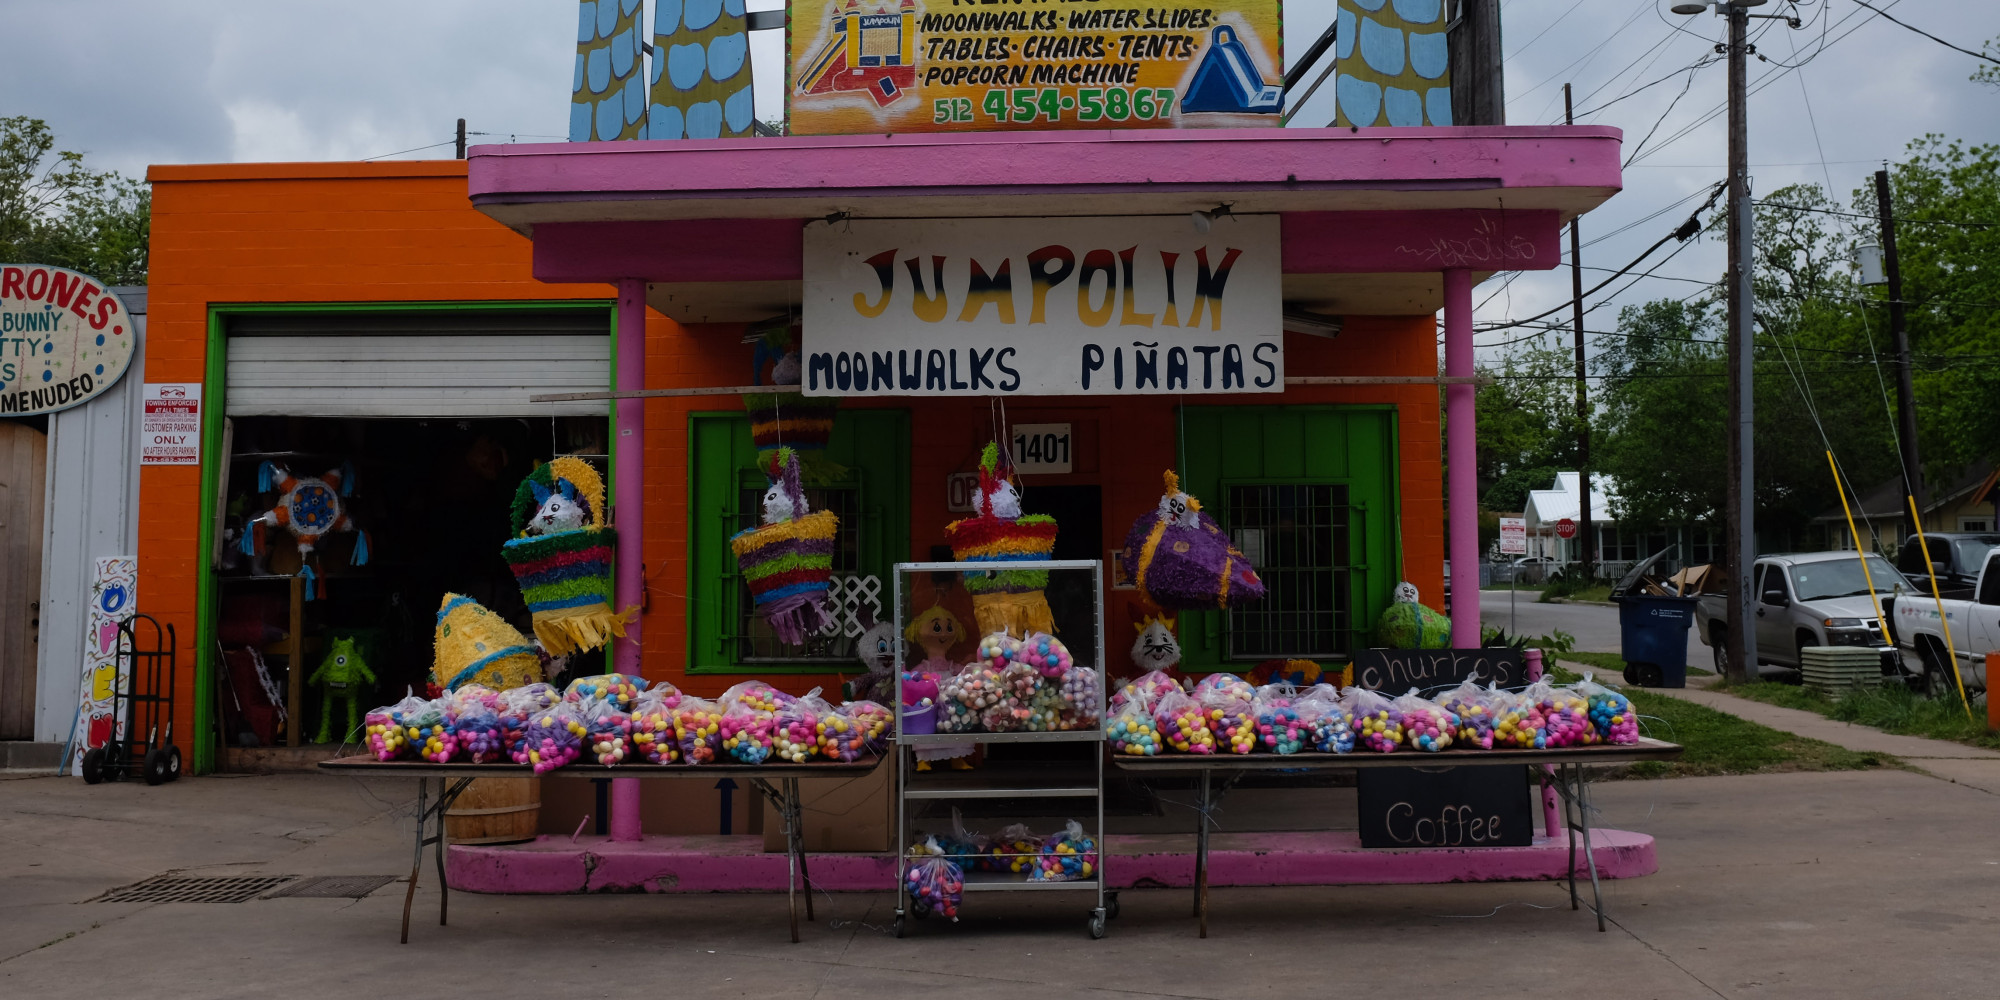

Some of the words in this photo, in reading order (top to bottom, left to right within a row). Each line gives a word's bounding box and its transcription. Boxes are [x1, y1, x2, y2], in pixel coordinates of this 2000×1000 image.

[920, 10, 1057, 33] MOONWALKS
[1068, 9, 1140, 31] WATER
[1142, 8, 1212, 30] SLIDES
[927, 36, 1010, 60] TABLES
[1023, 35, 1105, 59] CHAIRS
[1119, 34, 1192, 58] TENTS
[924, 64, 1028, 86] POPCORN
[1030, 62, 1140, 84] MACHINE
[934, 98, 974, 123] 512
[853, 244, 1243, 331] JUMPOLIN
[3, 312, 63, 332] BUNNY
[809, 347, 1021, 392] MOONWALKS
[1082, 341, 1279, 390] PIÑATAS
[1, 373, 94, 413] MENUDEO
[144, 423, 172, 432] CUSTOMER
[174, 423, 197, 432] PARKING
[154, 435, 186, 444] ONLY
[143, 446, 149, 455] NO
[150, 446, 163, 455] AFTER
[164, 446, 178, 455] HOURS
[179, 446, 197, 455] PARKING
[1015, 433, 1069, 463] 1401
[1556, 524, 1575, 532] STOP
[1361, 650, 1513, 690] churros
[1386, 802, 1502, 845] Coffee
